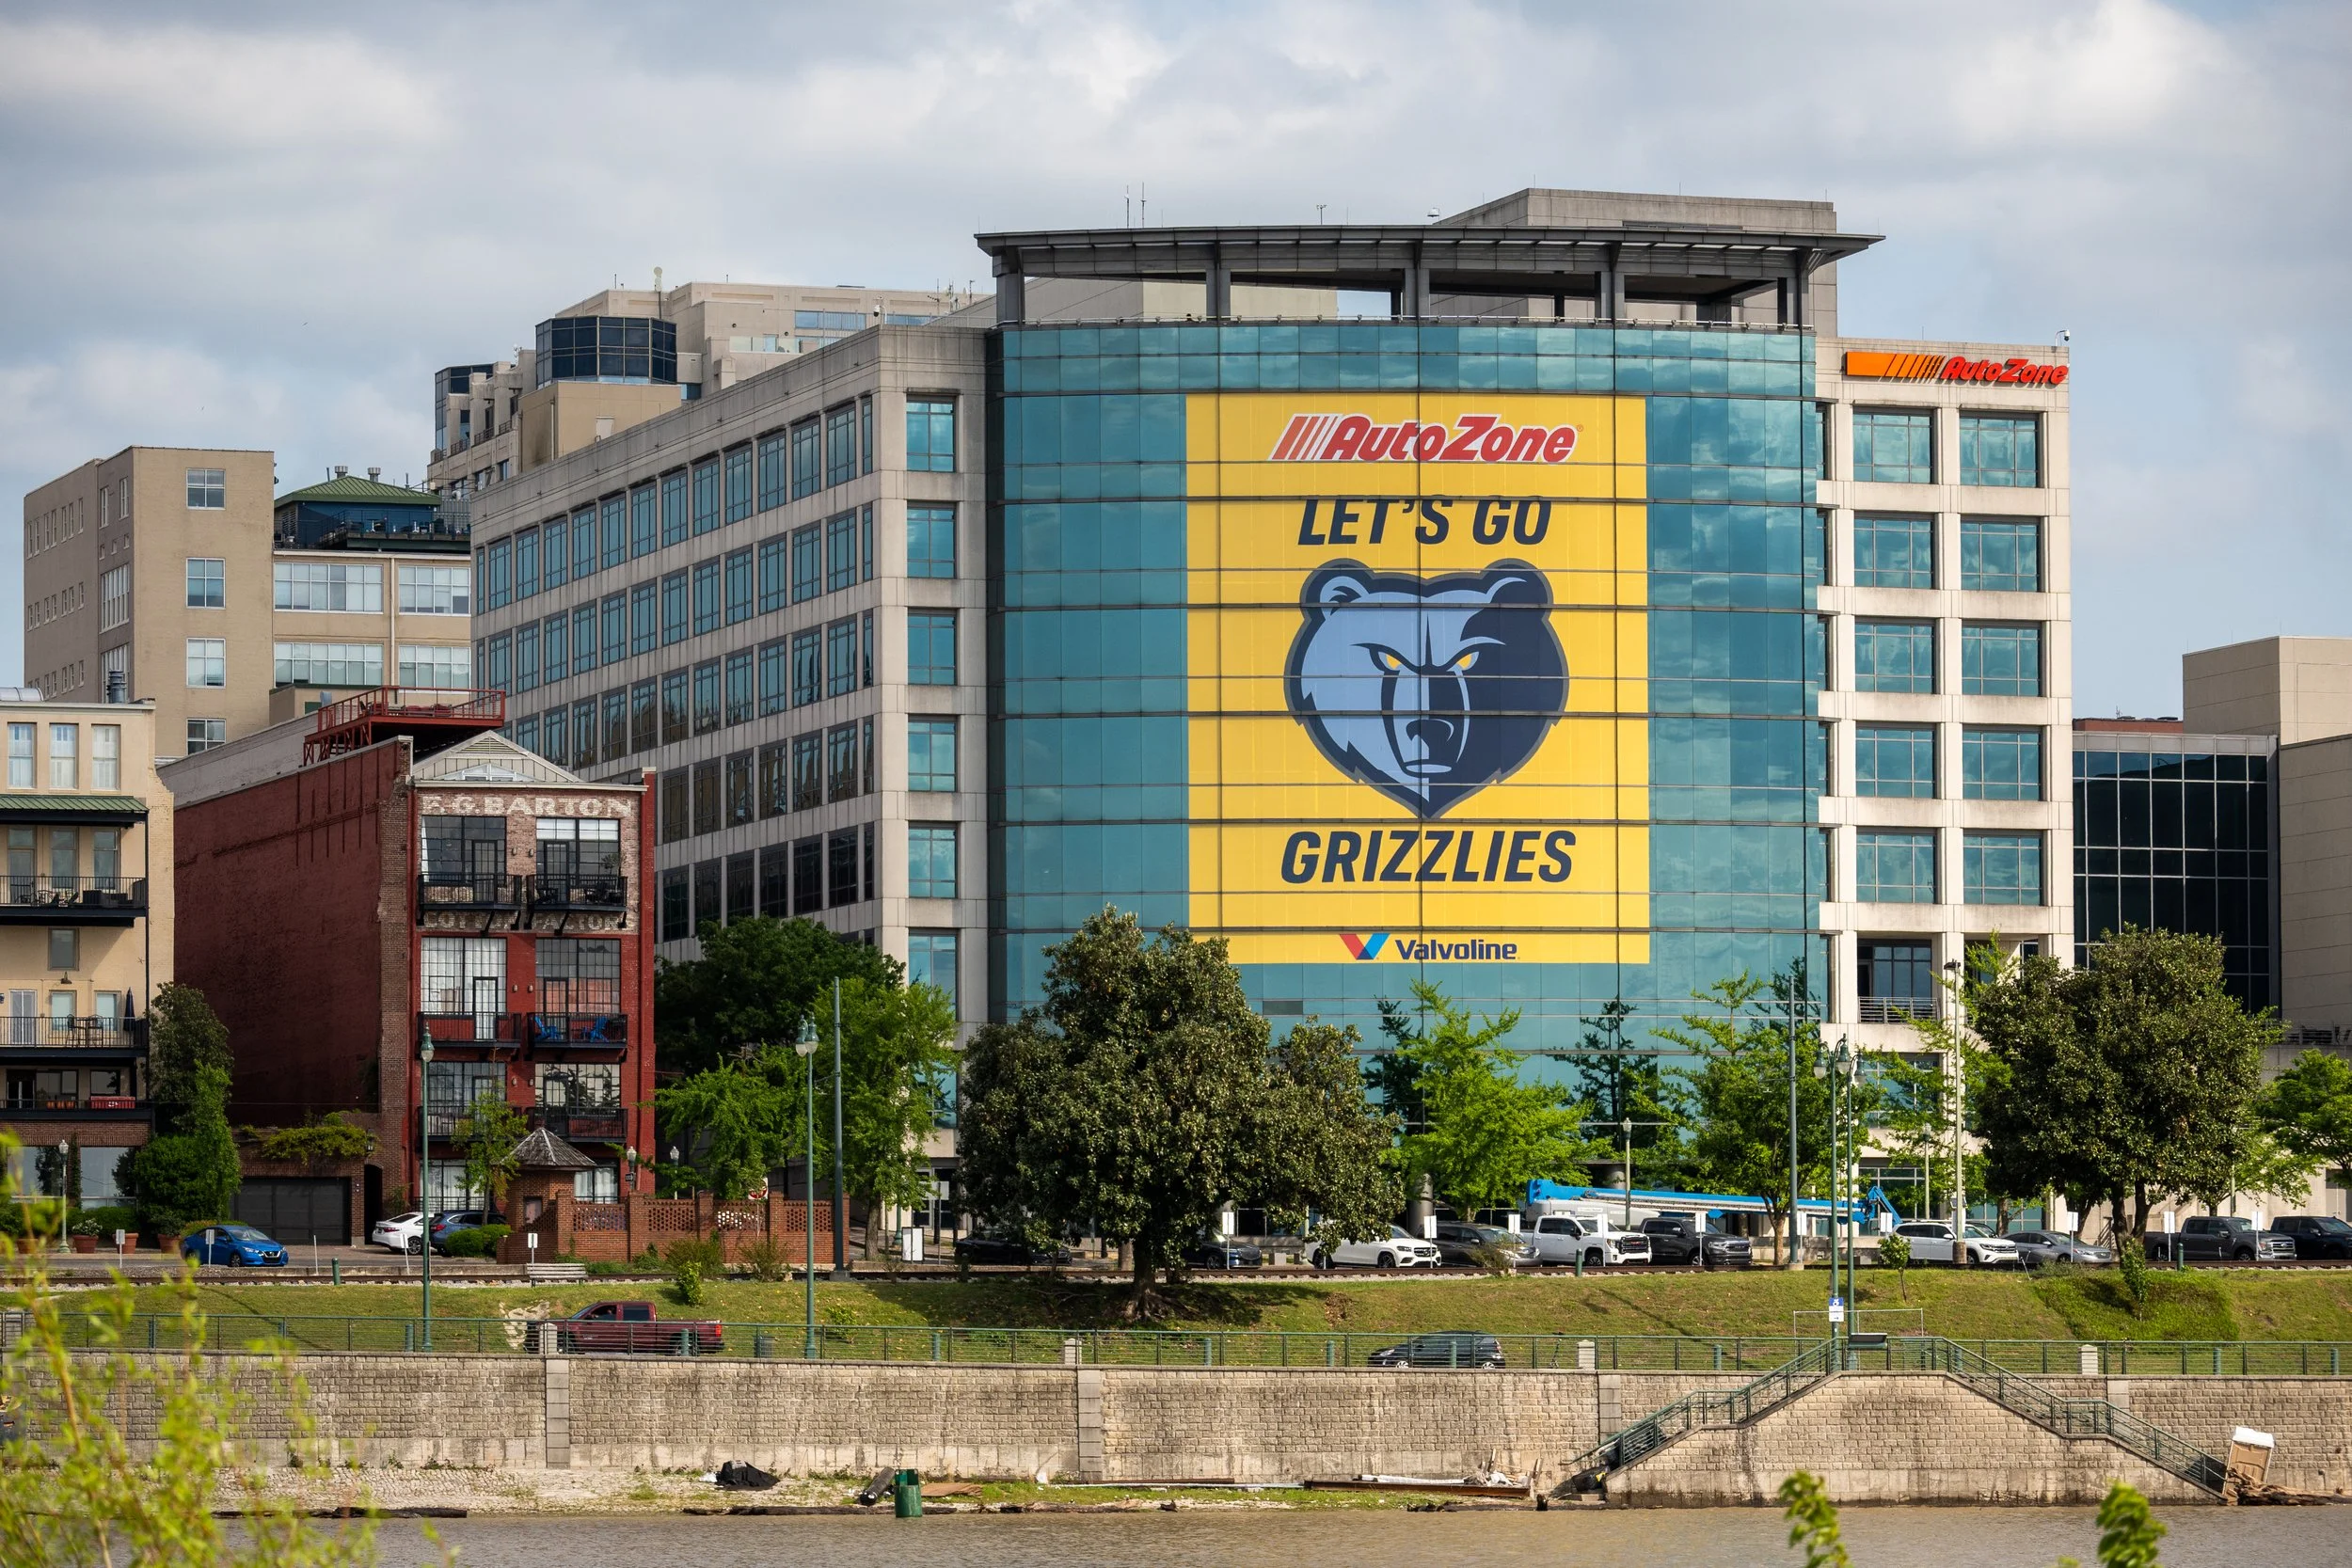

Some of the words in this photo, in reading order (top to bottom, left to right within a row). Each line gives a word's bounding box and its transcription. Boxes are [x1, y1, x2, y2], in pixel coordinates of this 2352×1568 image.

[1940, 356, 2069, 385] AutoZone
[1318, 414, 1577, 462] AutoZone
[1297, 495, 1454, 546] LET'S
[1472, 495, 1551, 546] GO
[1280, 830, 1577, 884] GRIZZLIES
[1395, 939, 1518, 960] Valvoline
